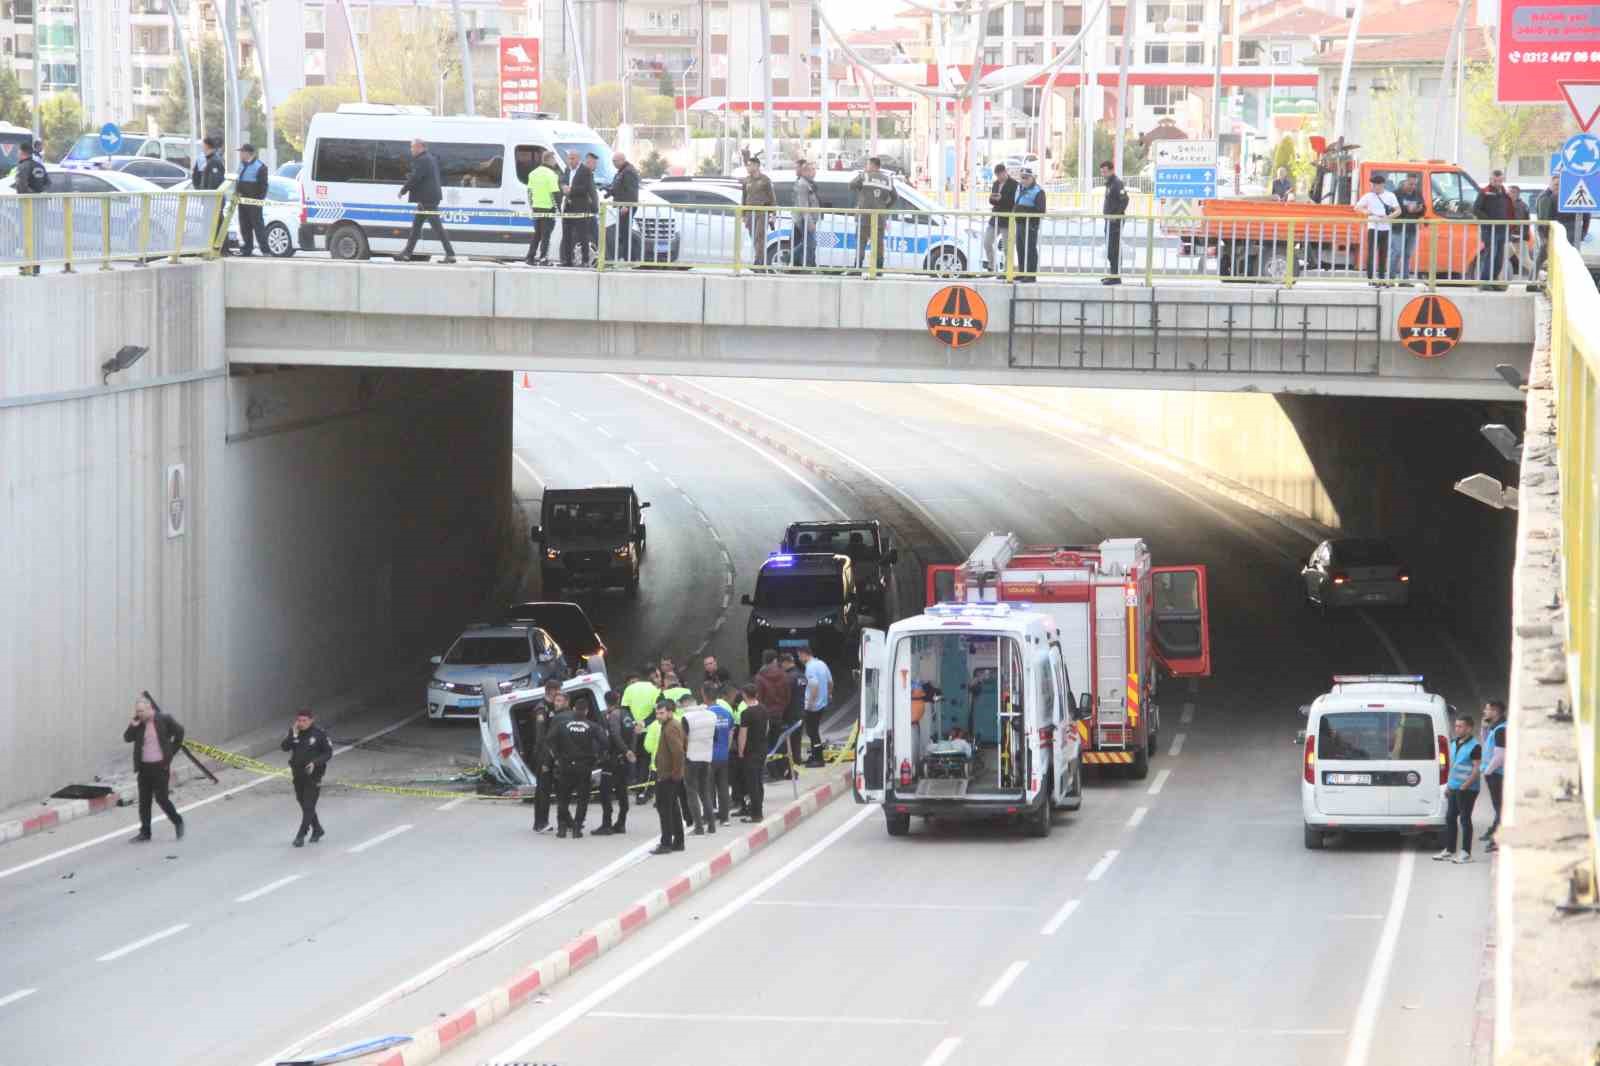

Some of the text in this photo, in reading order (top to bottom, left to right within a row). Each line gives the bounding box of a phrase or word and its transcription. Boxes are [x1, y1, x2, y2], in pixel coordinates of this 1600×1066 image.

[1550, 51, 1572, 63] 447
[1158, 187, 1194, 196] Mersin
[940, 316, 973, 328] TCK
[1410, 327, 1448, 337] TCK
